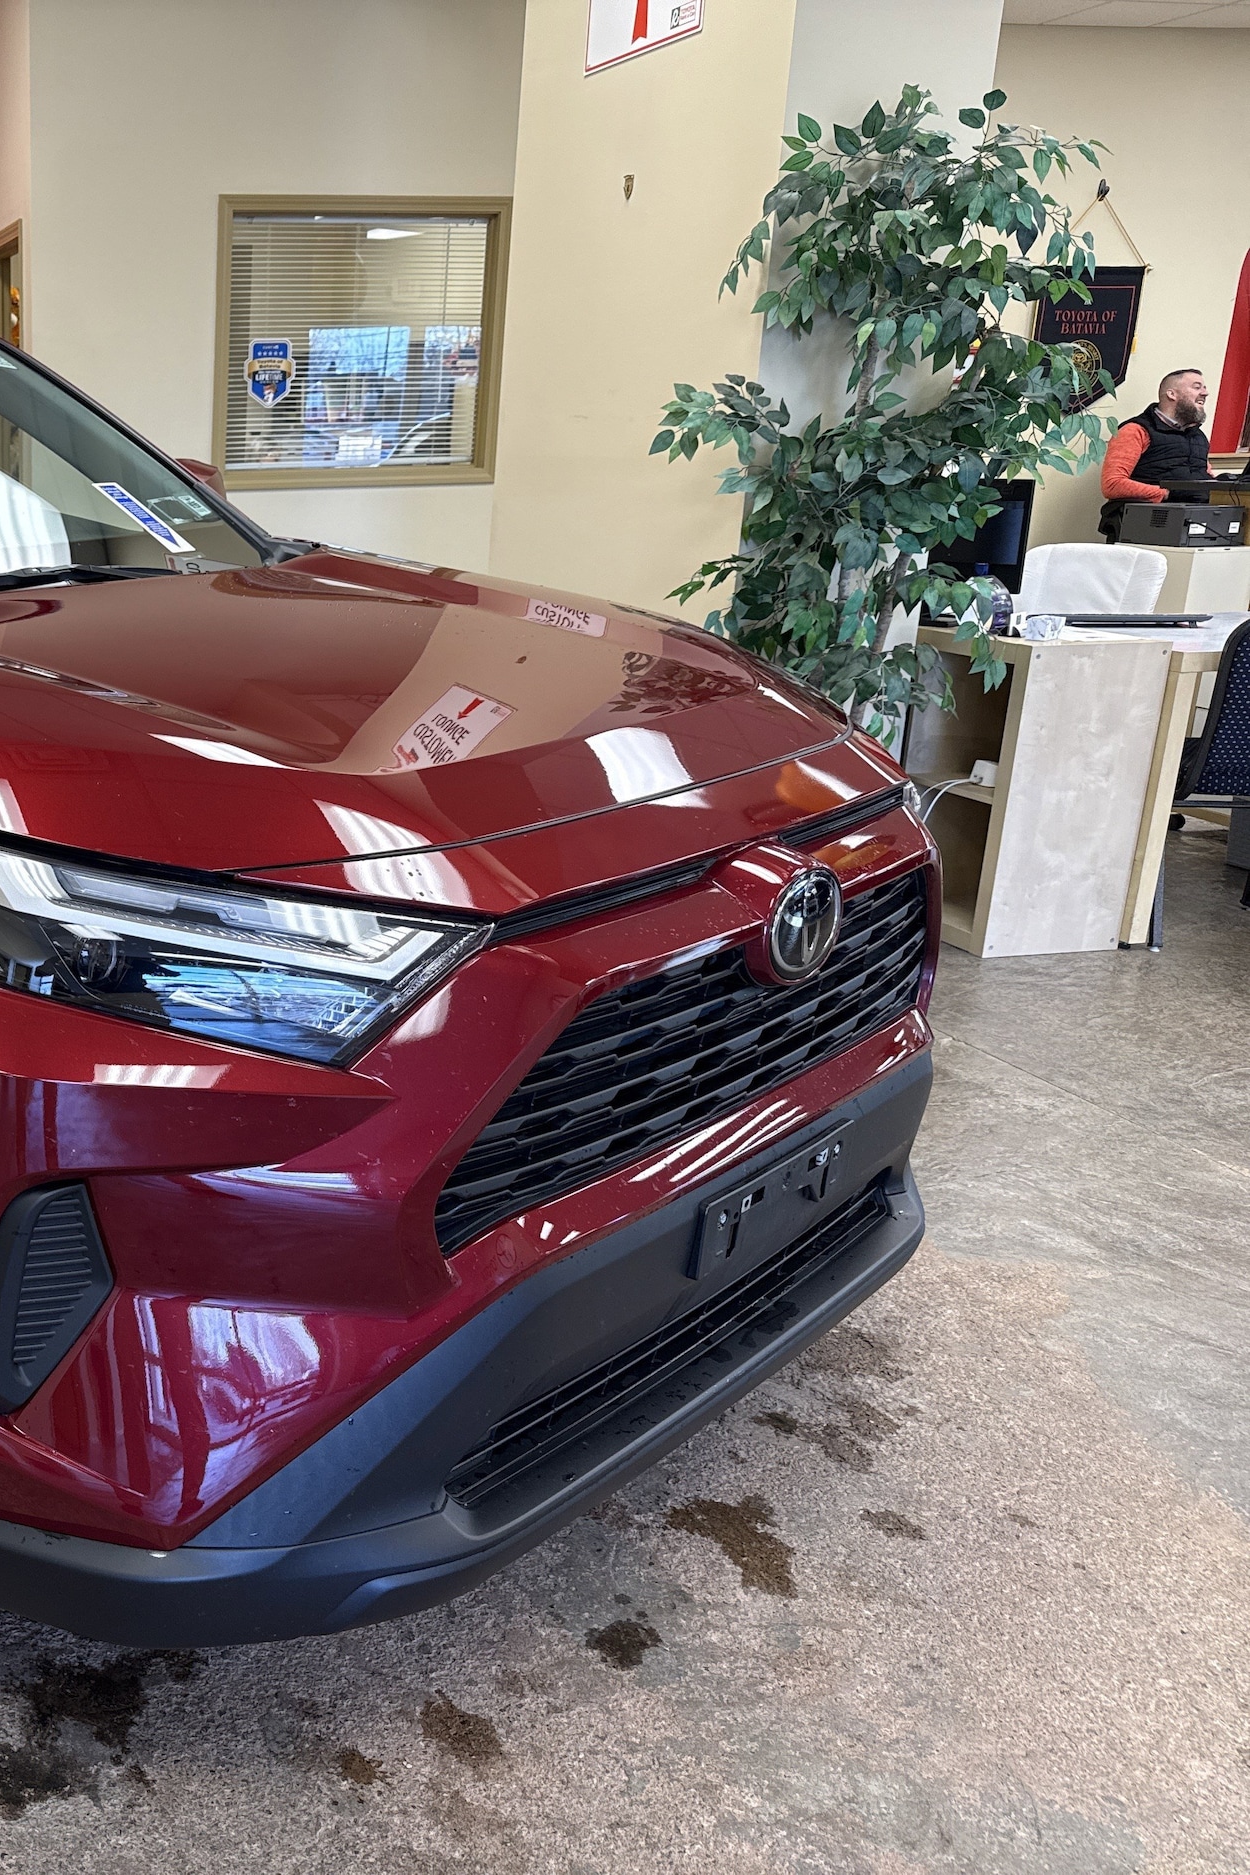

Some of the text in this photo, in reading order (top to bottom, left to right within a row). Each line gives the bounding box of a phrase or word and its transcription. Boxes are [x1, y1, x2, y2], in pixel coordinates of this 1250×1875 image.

[1055, 310, 1117, 322] TOYOTA OF
[1061, 322, 1106, 334] BATAVIA
